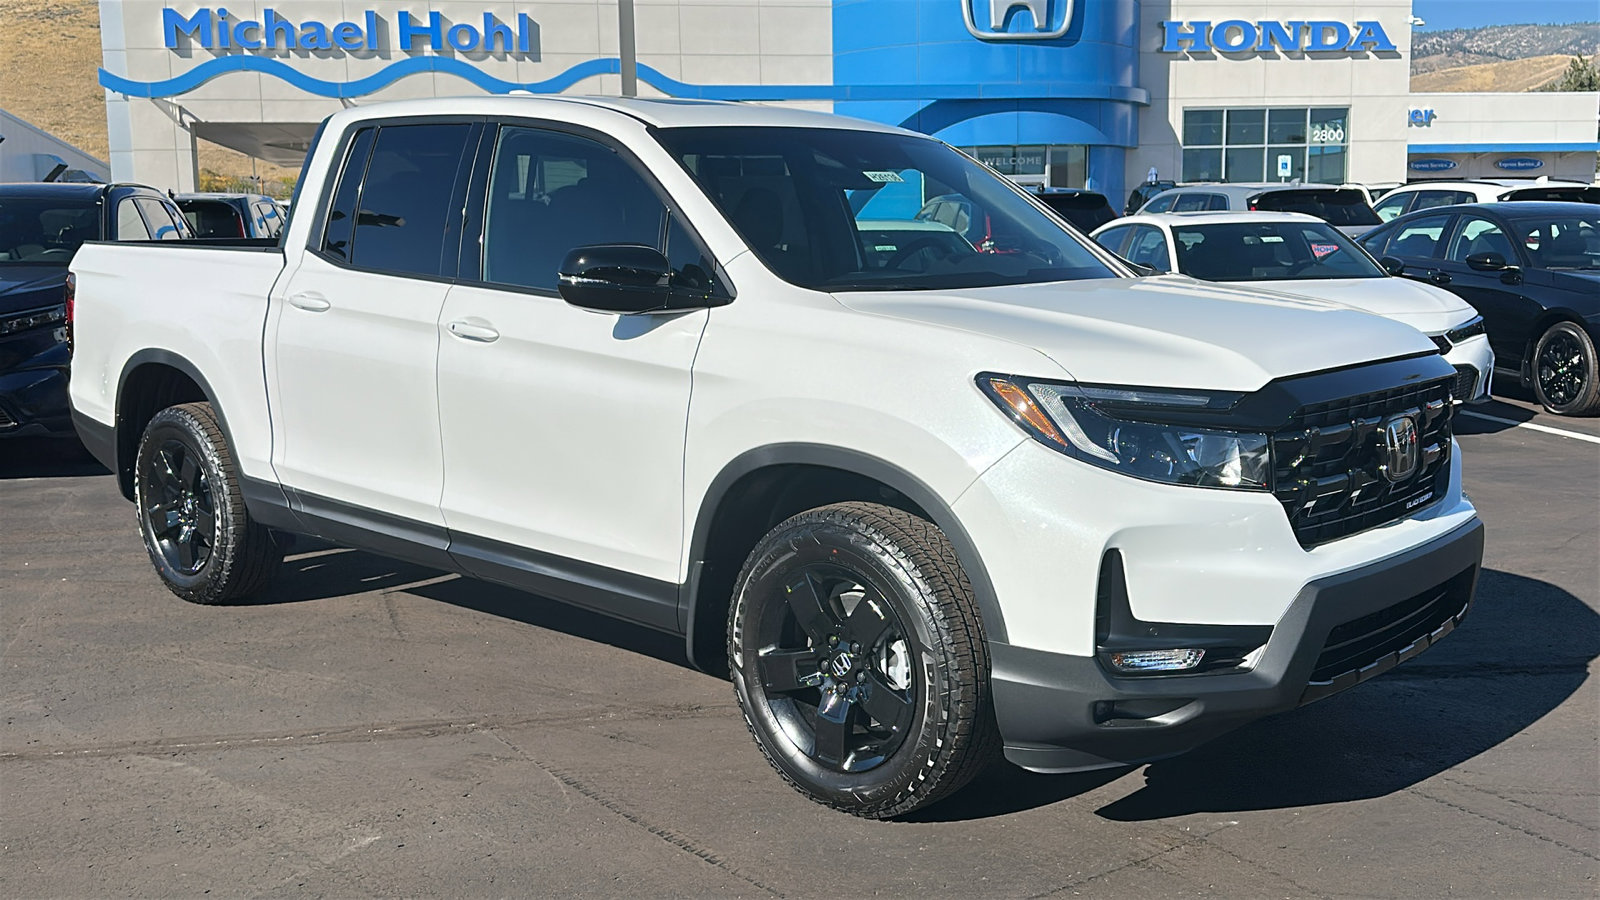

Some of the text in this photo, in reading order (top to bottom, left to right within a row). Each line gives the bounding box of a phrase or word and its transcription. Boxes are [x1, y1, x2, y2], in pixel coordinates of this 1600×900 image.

[162, 8, 530, 52] Michael Hohl
[1162, 20, 1398, 53] HONDA
[1409, 108, 1434, 122] er
[1312, 129, 1345, 142] 2800
[984, 156, 1042, 167] WELCOME
